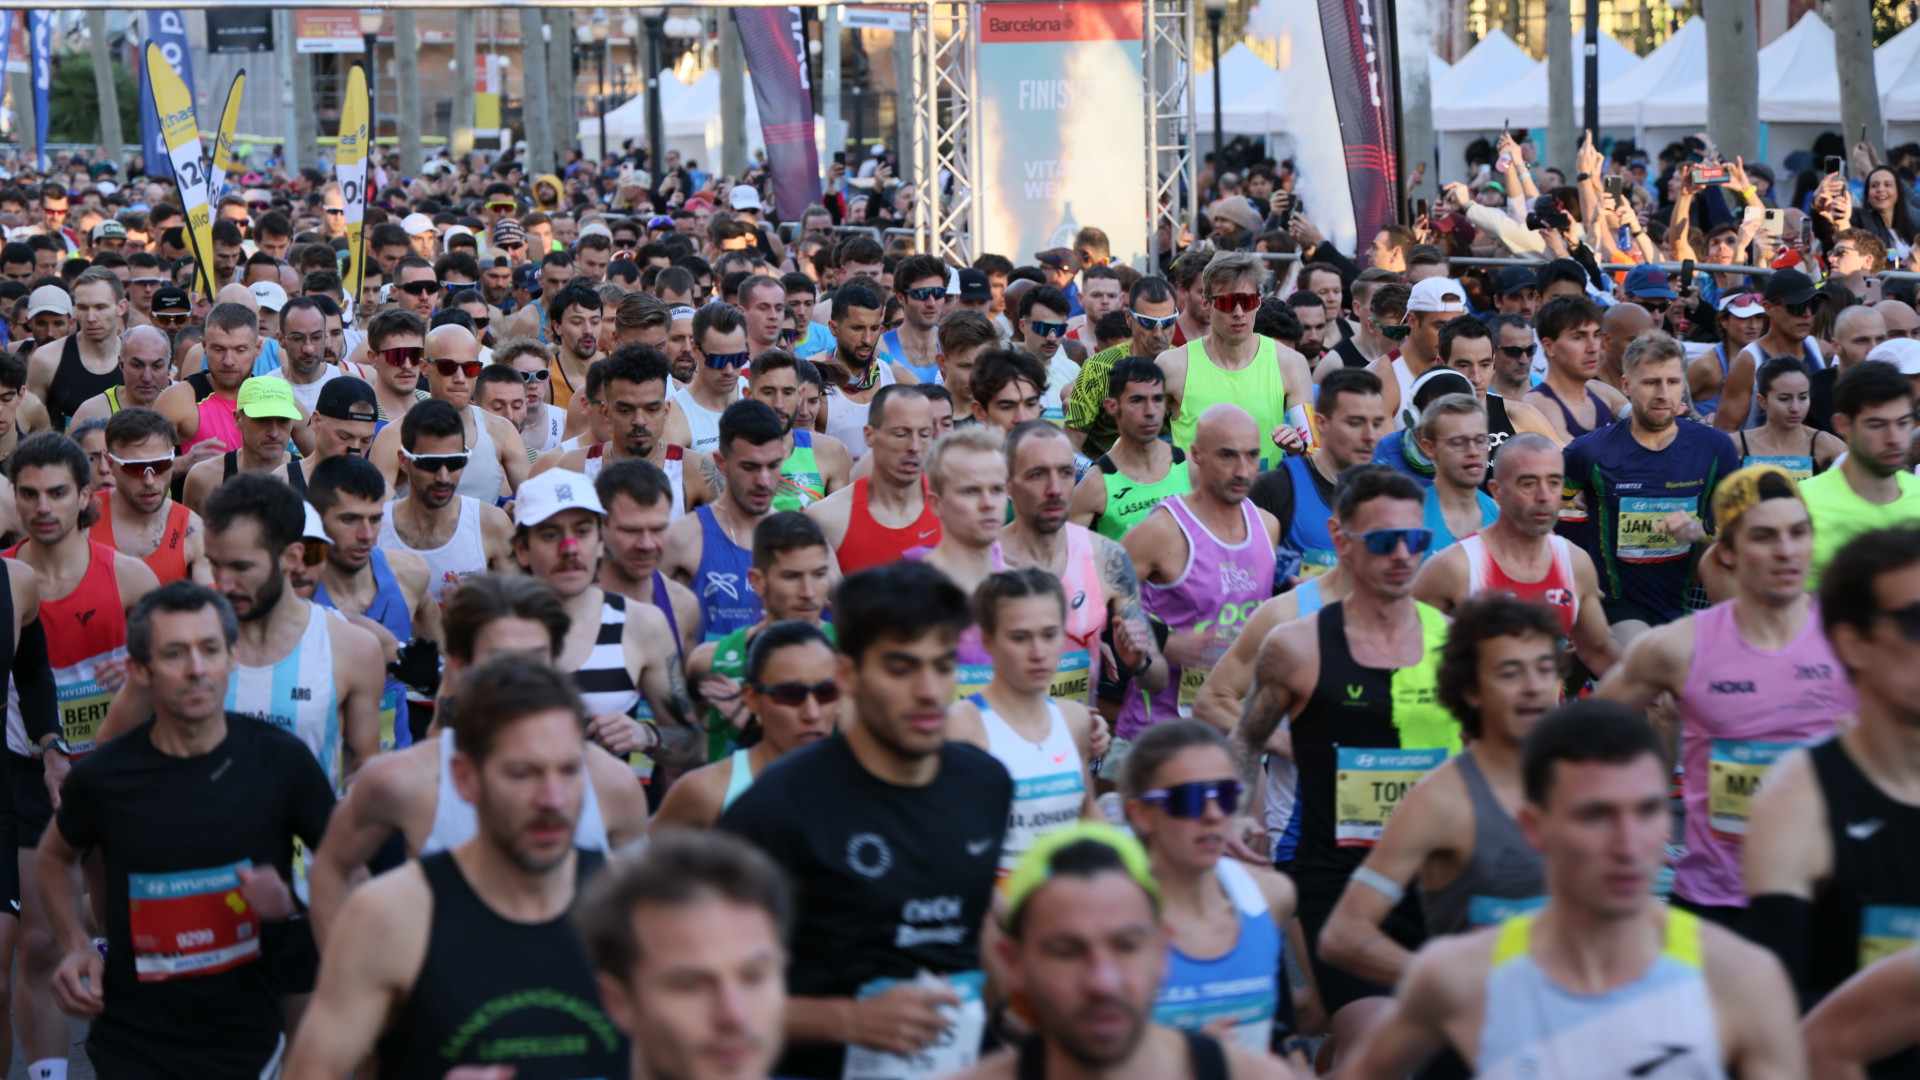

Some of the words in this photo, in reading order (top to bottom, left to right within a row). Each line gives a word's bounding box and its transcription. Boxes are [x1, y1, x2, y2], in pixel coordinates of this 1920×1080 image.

[989, 17, 1061, 33] Barcelona
[1623, 520, 1652, 533] JAN
[61, 683, 108, 698] HYUNDI
[291, 688, 311, 700] ARG
[64, 701, 111, 725] BERT
[66, 725, 91, 737] 1728
[1380, 755, 1433, 766] HYUNDAI
